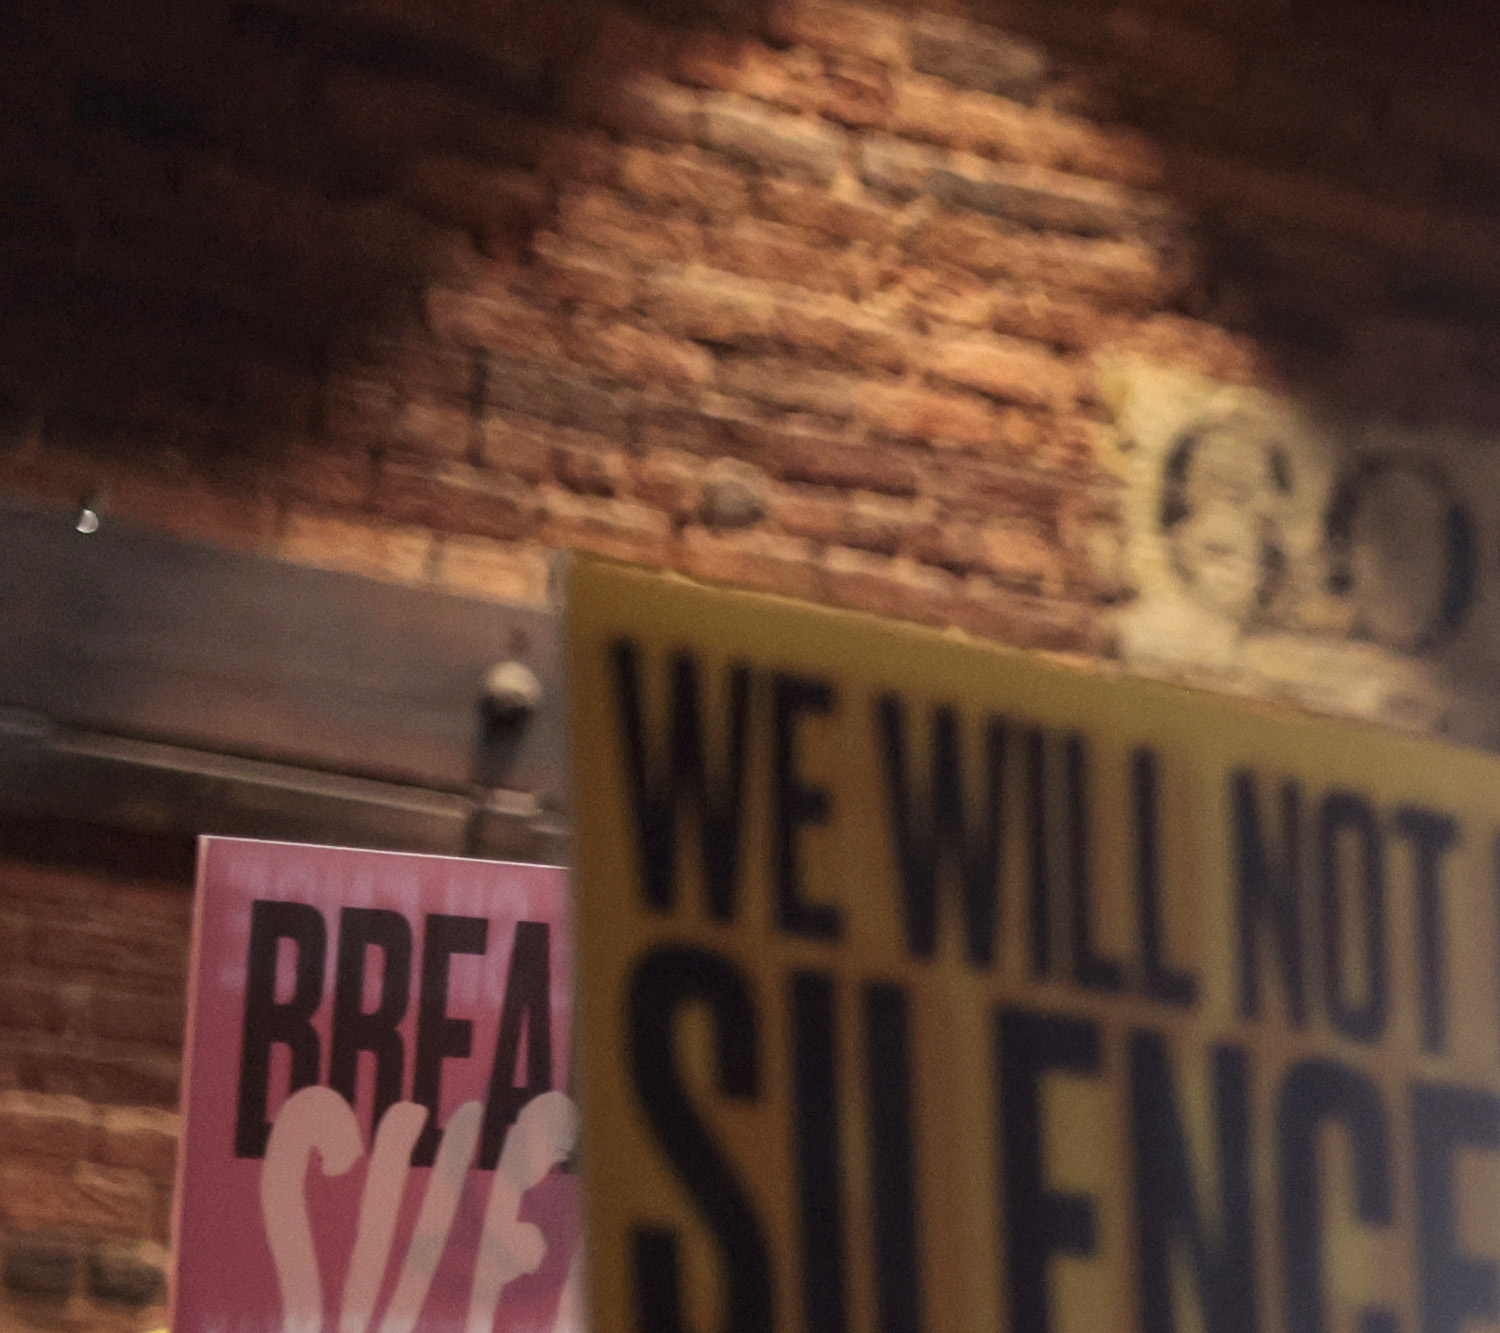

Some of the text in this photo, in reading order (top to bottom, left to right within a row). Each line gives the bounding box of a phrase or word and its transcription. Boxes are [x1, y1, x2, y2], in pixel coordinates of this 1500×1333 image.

[610, 635, 848, 944] WE
[874, 686, 1203, 1010] WILL
[1229, 758, 1462, 1059] NOT
[234, 898, 570, 1173] BREA
